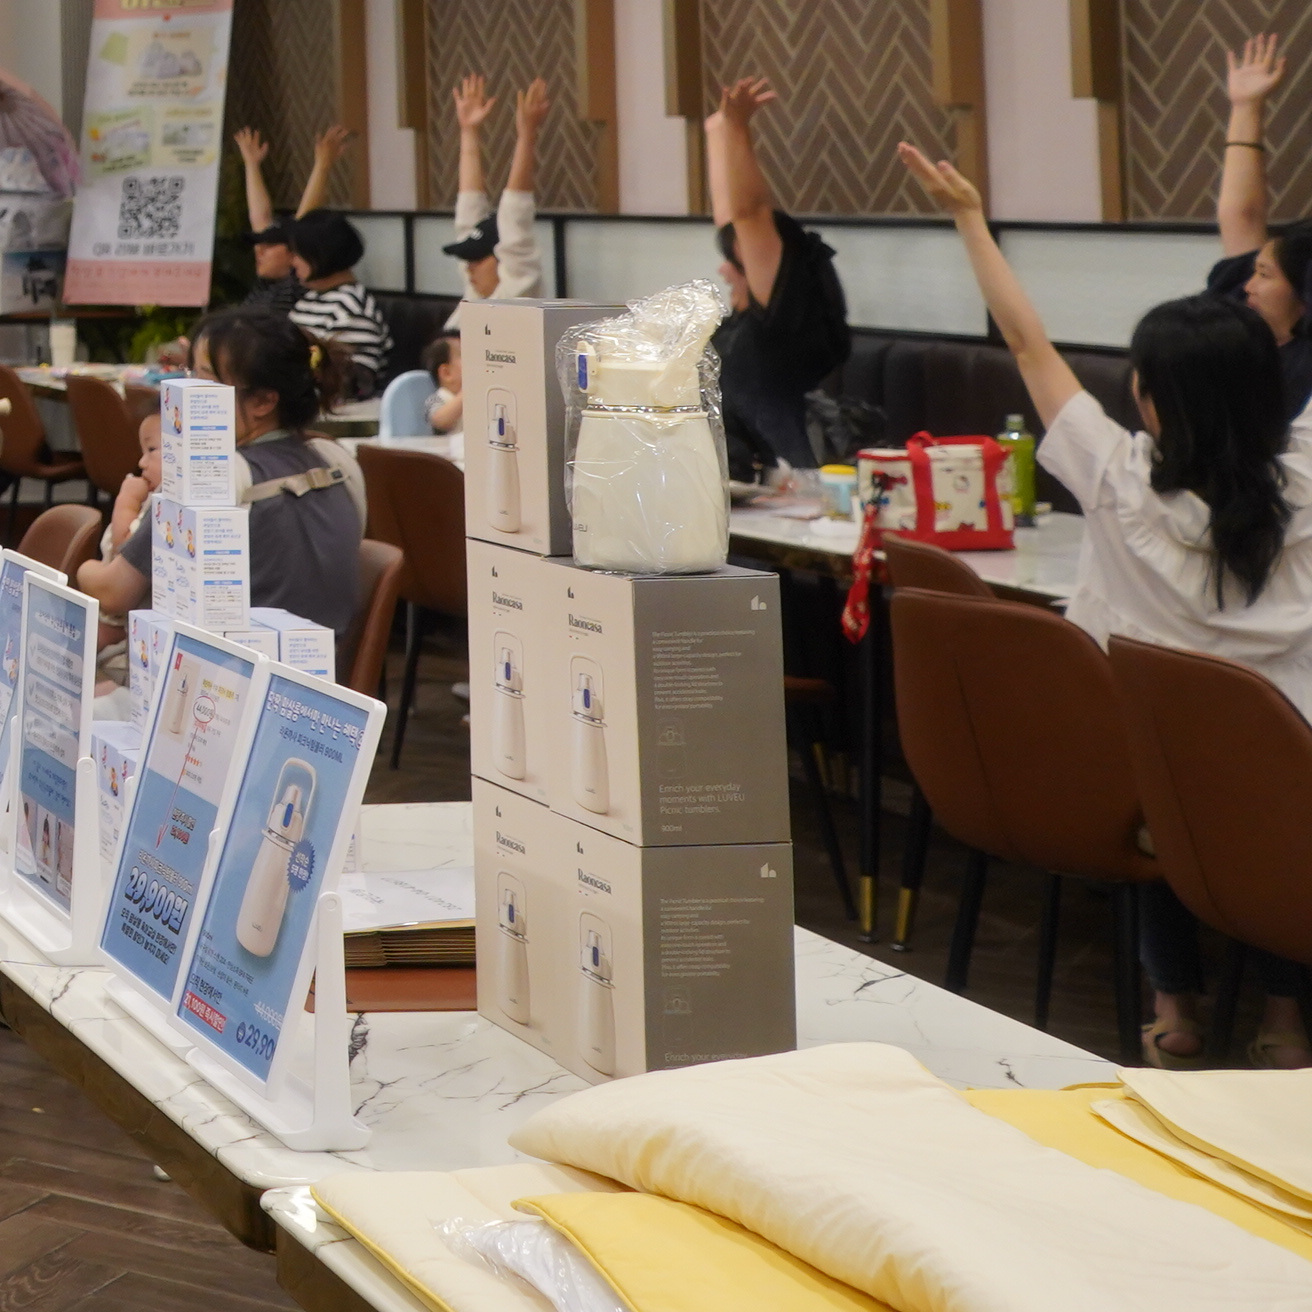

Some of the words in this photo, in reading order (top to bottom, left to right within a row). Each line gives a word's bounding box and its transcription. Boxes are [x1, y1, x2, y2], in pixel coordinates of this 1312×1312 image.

[317, 711, 343, 741] 만나는
[659, 784, 684, 793] Enrich
[705, 782, 741, 792] everyday
[659, 795, 697, 804] moments
[698, 794, 716, 803] with
[717, 792, 745, 802] LUVEU
[122, 862, 190, 938] 29,900원
[243, 1022, 276, 1064] 29,90
